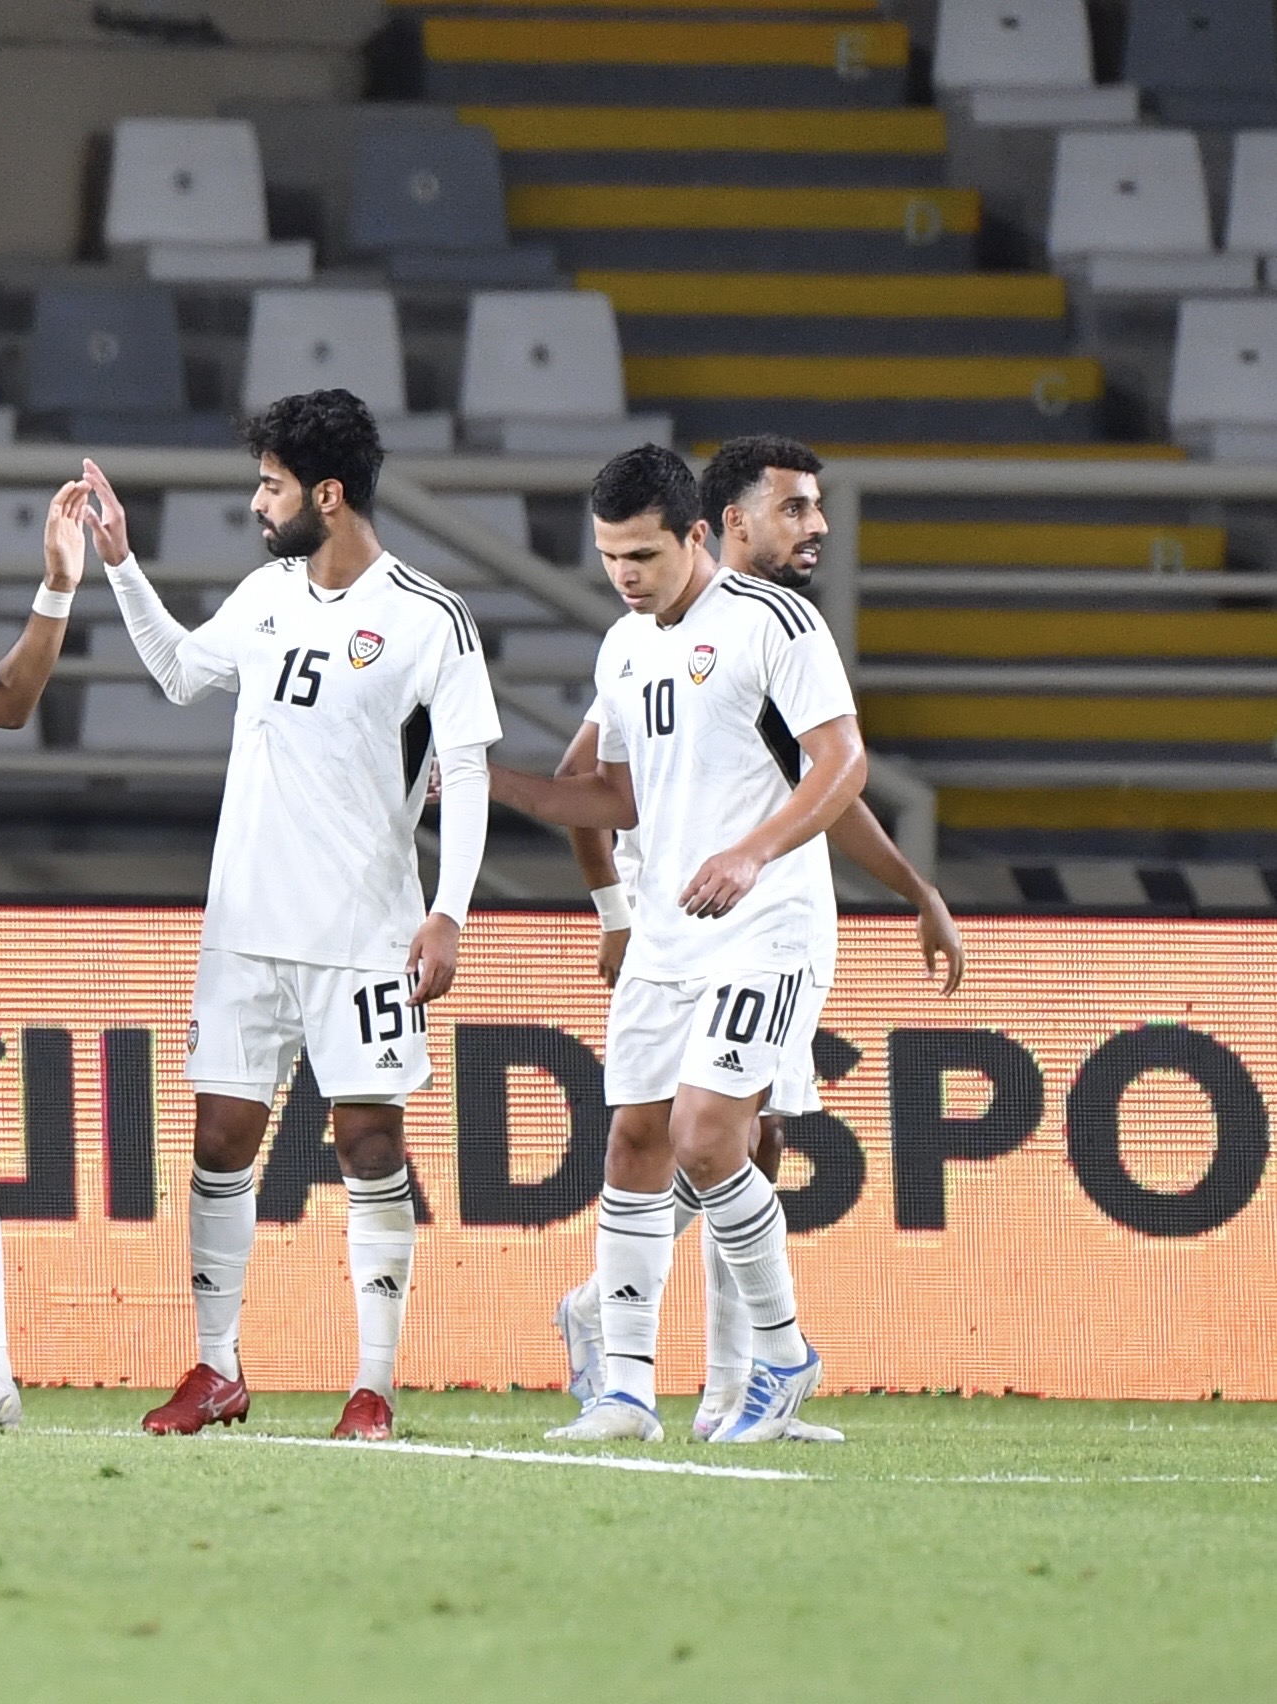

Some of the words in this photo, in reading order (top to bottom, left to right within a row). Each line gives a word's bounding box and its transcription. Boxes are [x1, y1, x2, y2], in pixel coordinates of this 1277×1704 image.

[273, 647, 331, 707] 15
[642, 677, 675, 738] 10
[353, 980, 403, 1045] 15
[706, 983, 766, 1044] 10
[375, 1060, 403, 1069] adidas
[361, 1285, 403, 1300] adidas
